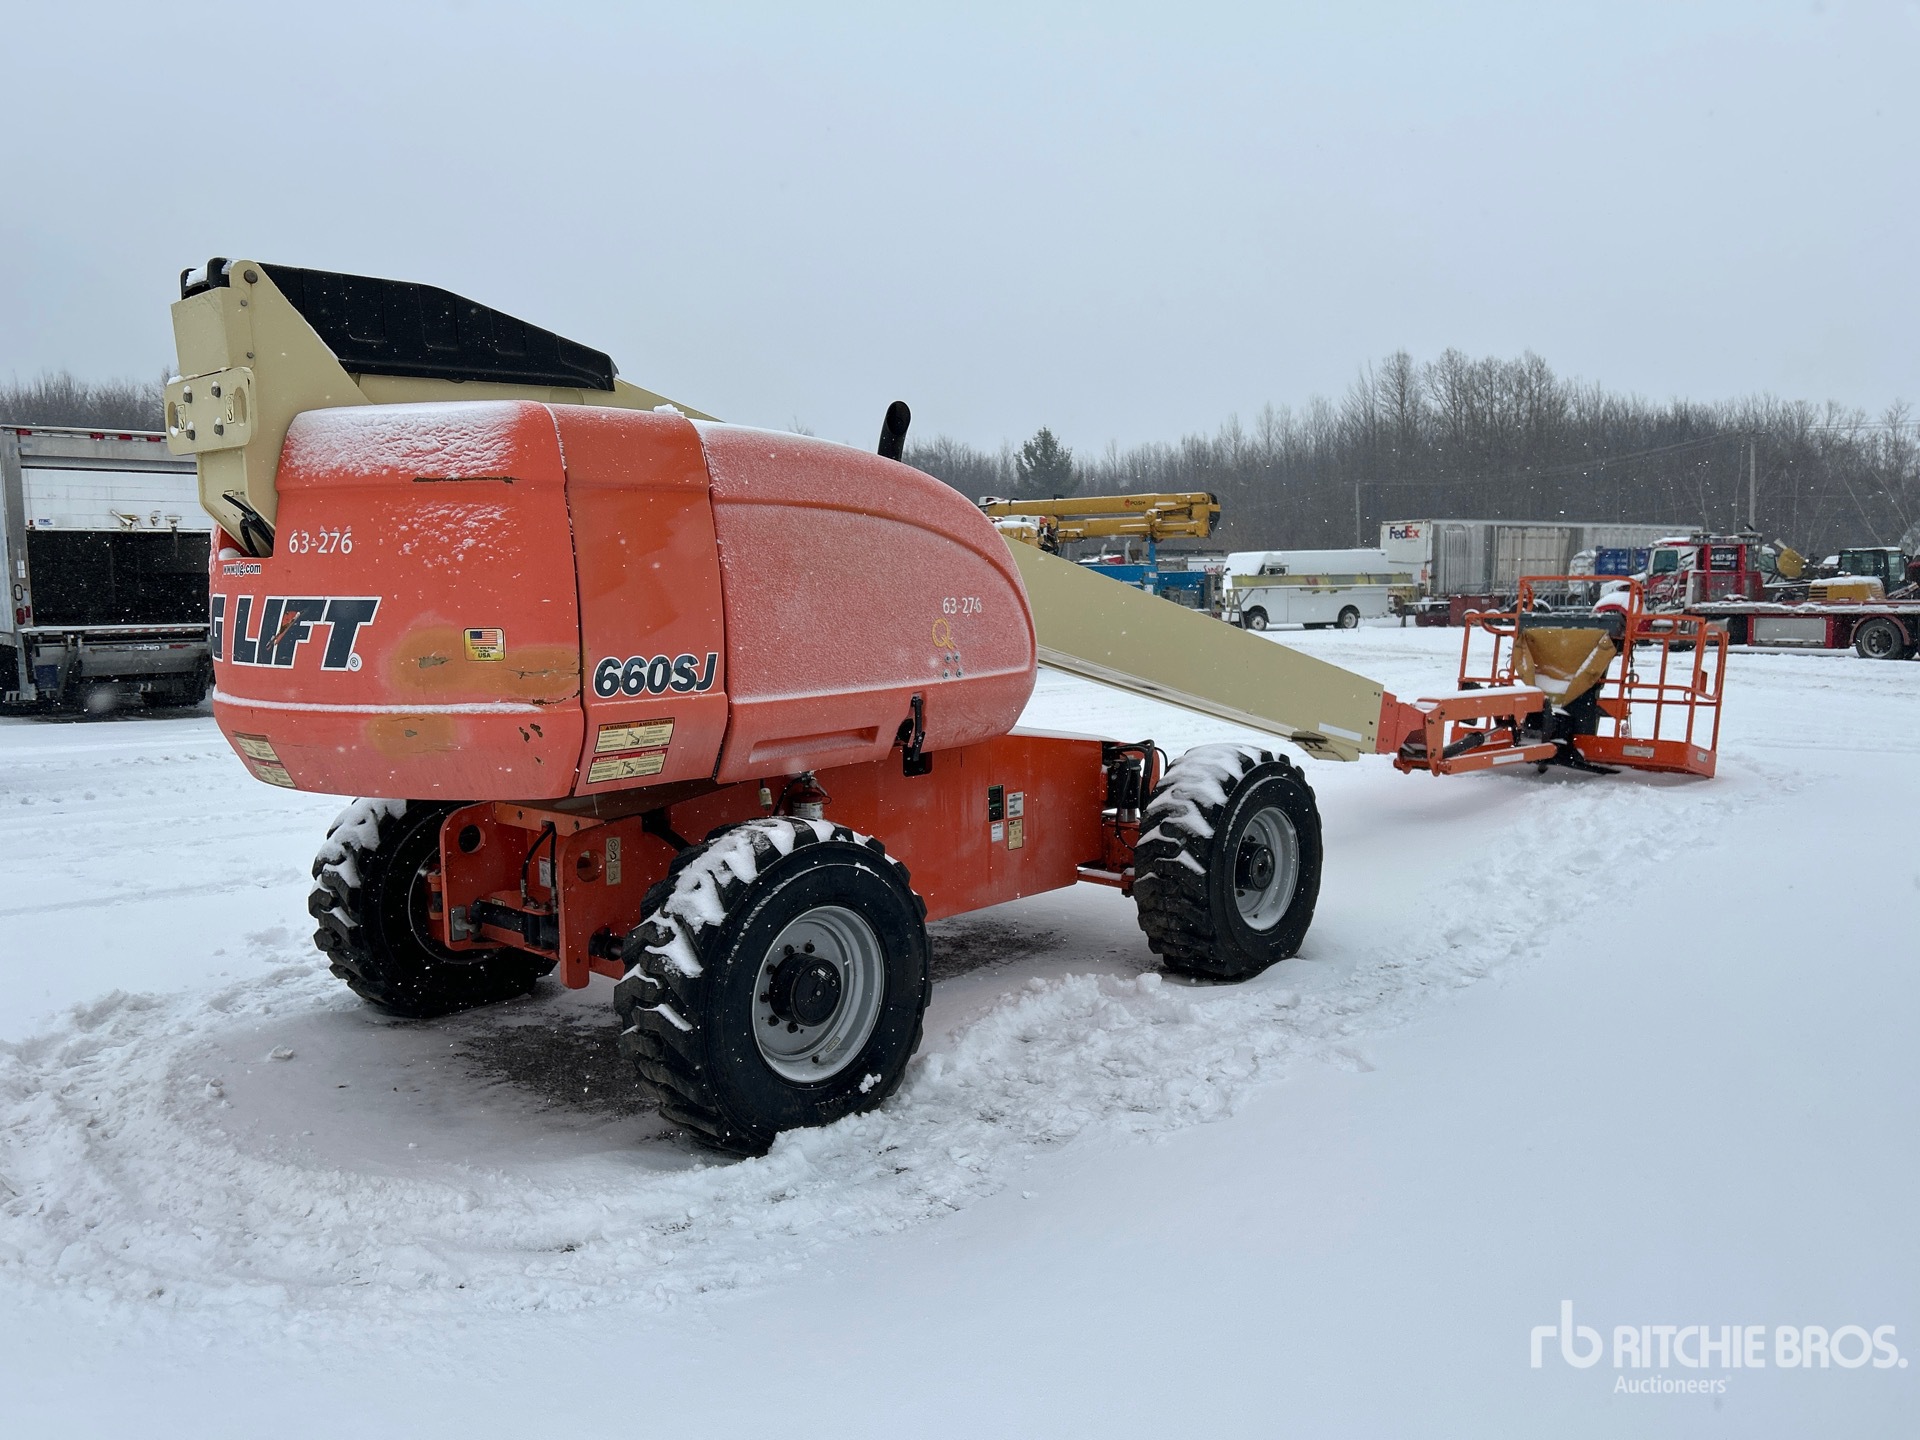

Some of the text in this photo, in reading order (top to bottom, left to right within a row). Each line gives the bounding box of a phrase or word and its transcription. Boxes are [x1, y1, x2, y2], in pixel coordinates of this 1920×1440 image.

[289, 532, 353, 554] 63-276
[1390, 525, 1420, 539] FedEx
[223, 562, 262, 577] www.jlg.com
[943, 597, 982, 614] 63-276
[232, 595, 382, 671] LIFT
[932, 618, 955, 649] Q
[593, 652, 719, 698] 660SJ
